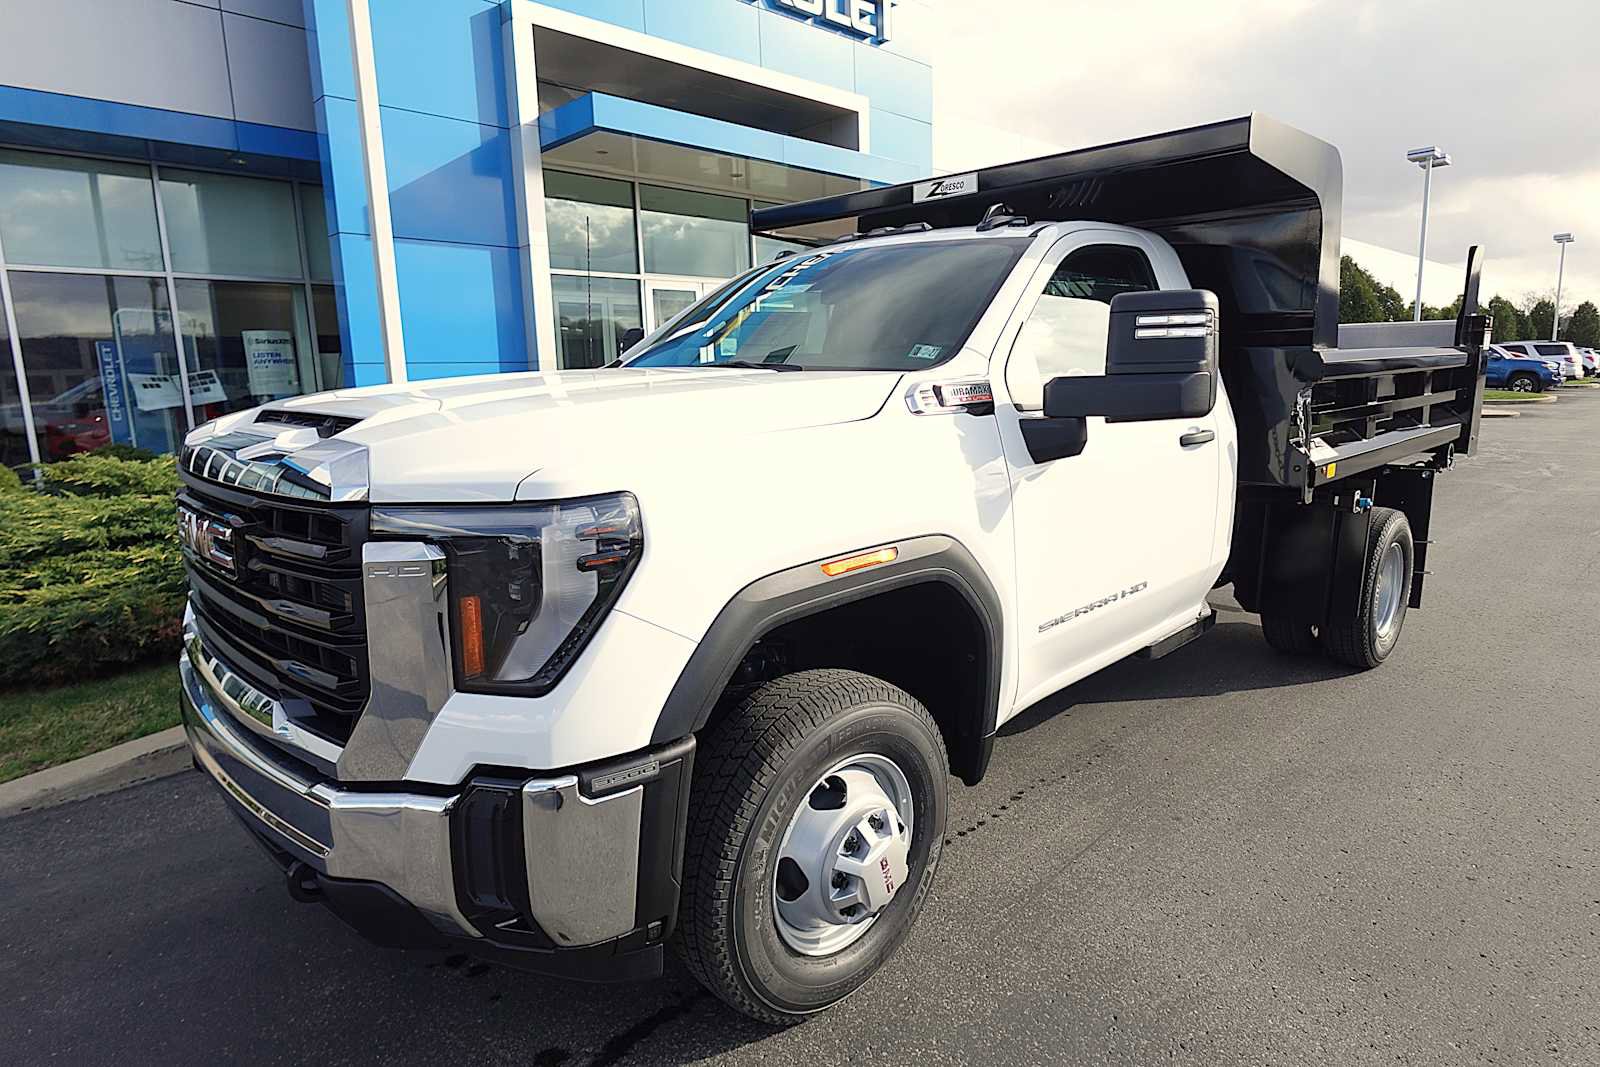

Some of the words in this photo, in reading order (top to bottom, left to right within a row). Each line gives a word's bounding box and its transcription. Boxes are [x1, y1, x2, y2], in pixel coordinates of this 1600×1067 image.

[925, 180, 965, 198] ZORESCO
[101, 345, 122, 422] CHEVROLET
[1038, 593, 1118, 633] SIERRA
[1120, 580, 1147, 599] HD
[879, 856, 895, 894] GMC
